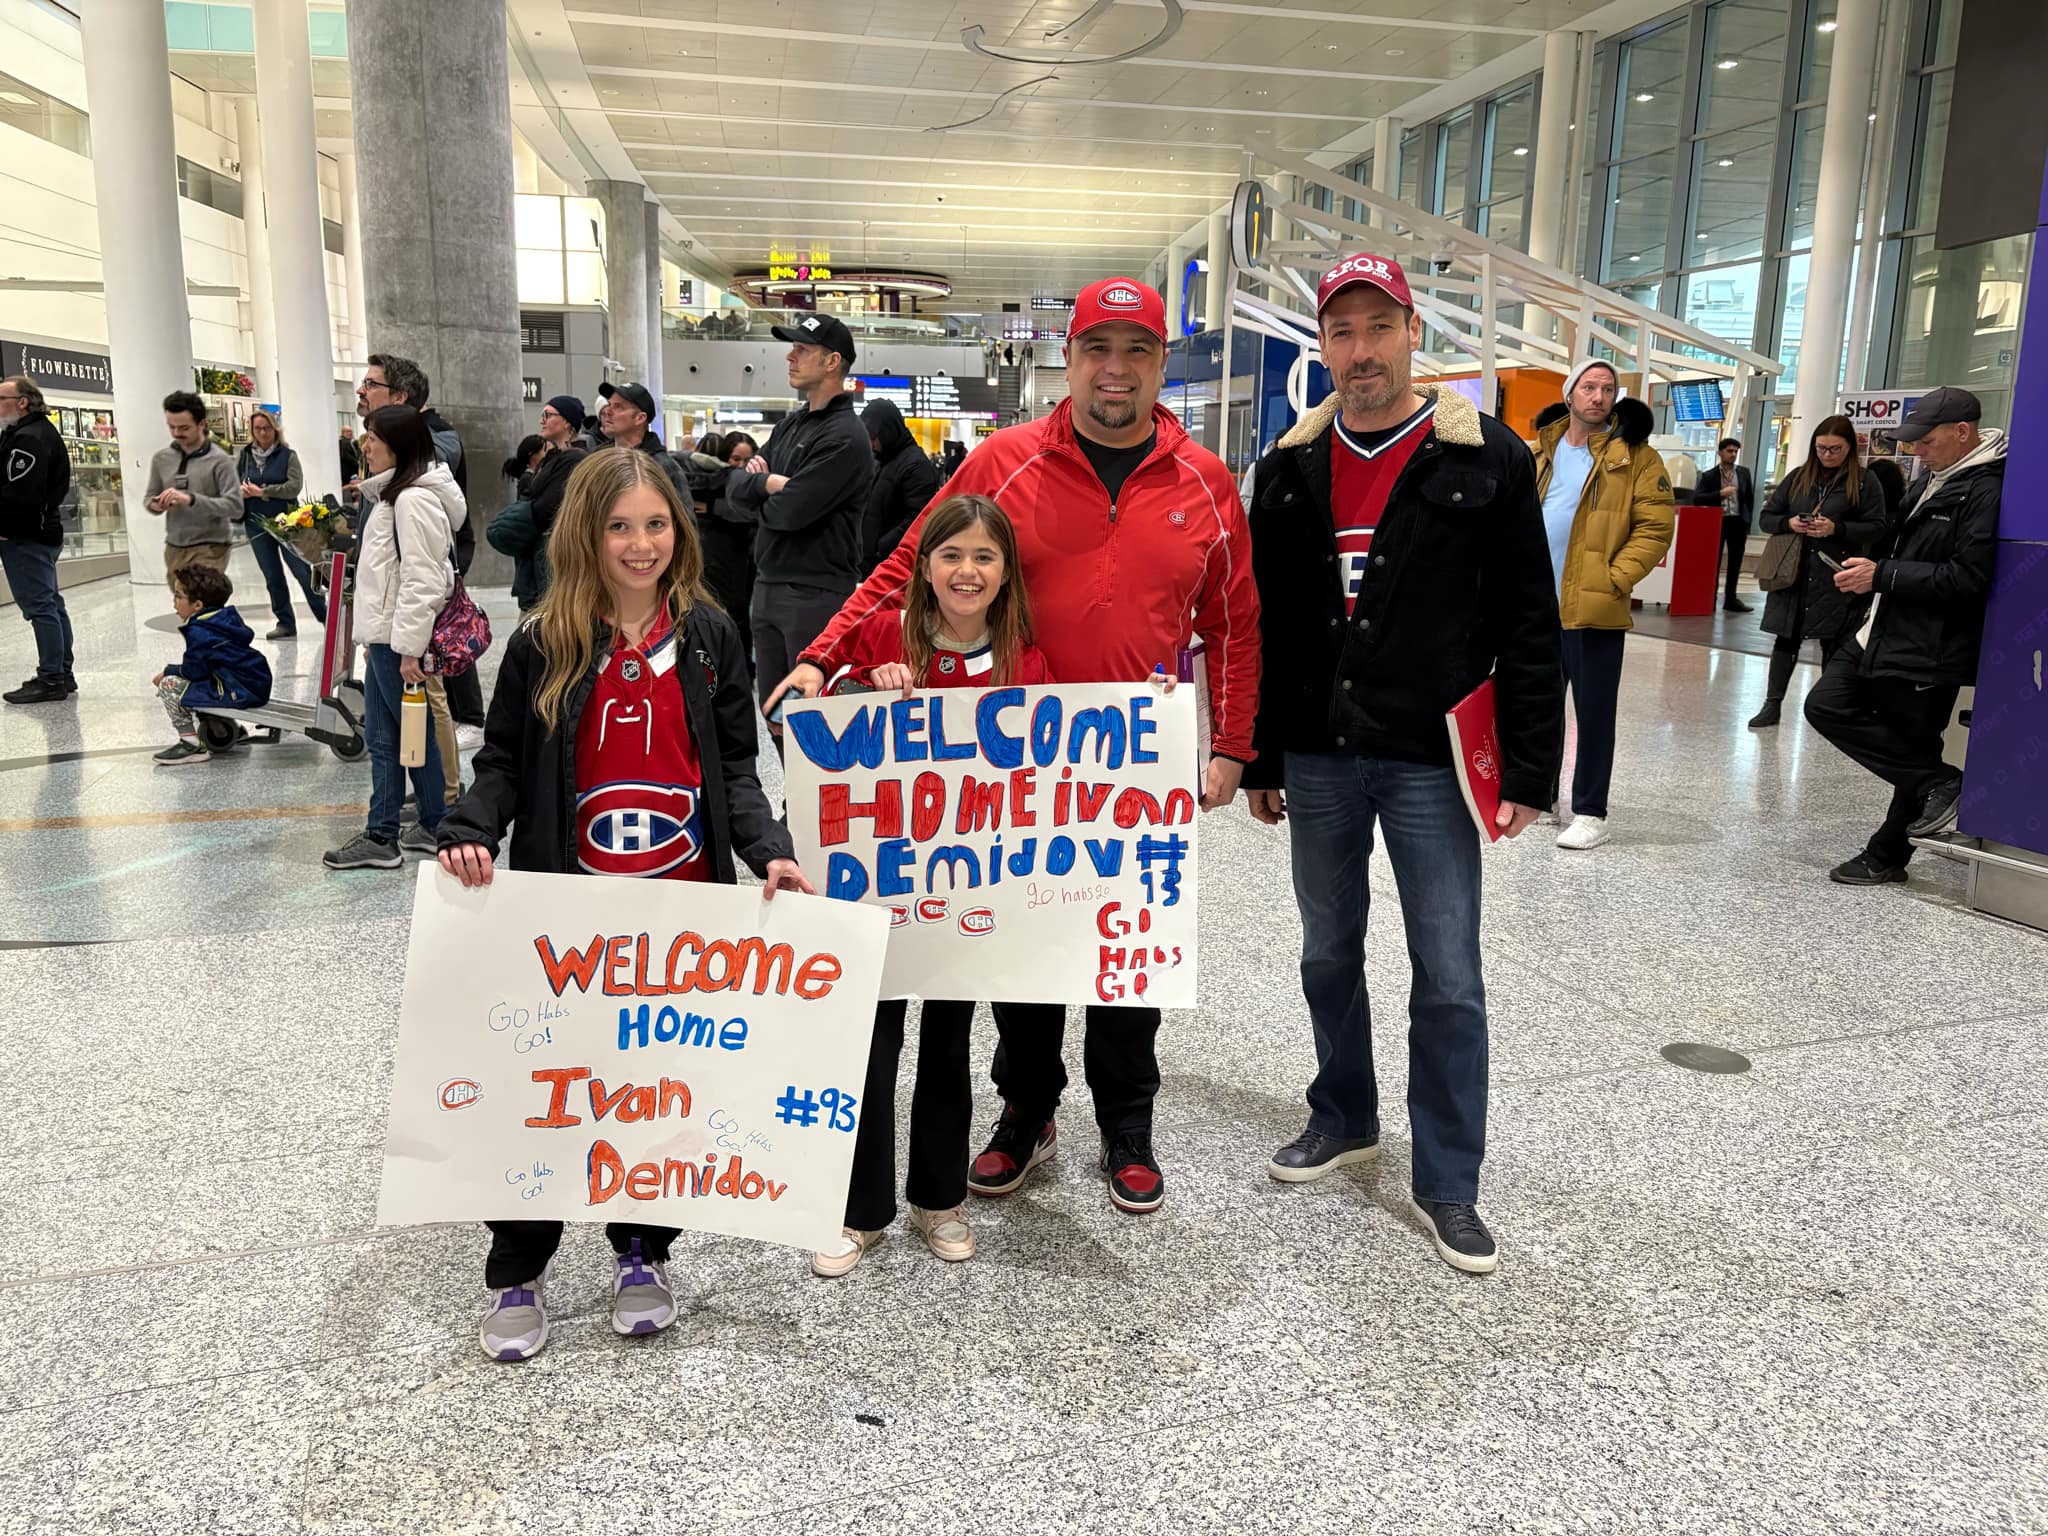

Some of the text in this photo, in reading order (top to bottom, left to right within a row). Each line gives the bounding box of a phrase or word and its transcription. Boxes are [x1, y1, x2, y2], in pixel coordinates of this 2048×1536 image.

[30, 357, 105, 381] FLOWERETTE
[1844, 400, 1901, 418] SHOP
[1062, 887, 1094, 904] habs
[1096, 901, 1151, 939] GO
[1095, 971, 1148, 1002] GO
[537, 1000, 570, 1023] Habs
[524, 1066, 692, 1129] Ivan
[587, 1139, 788, 1206] Demidov
